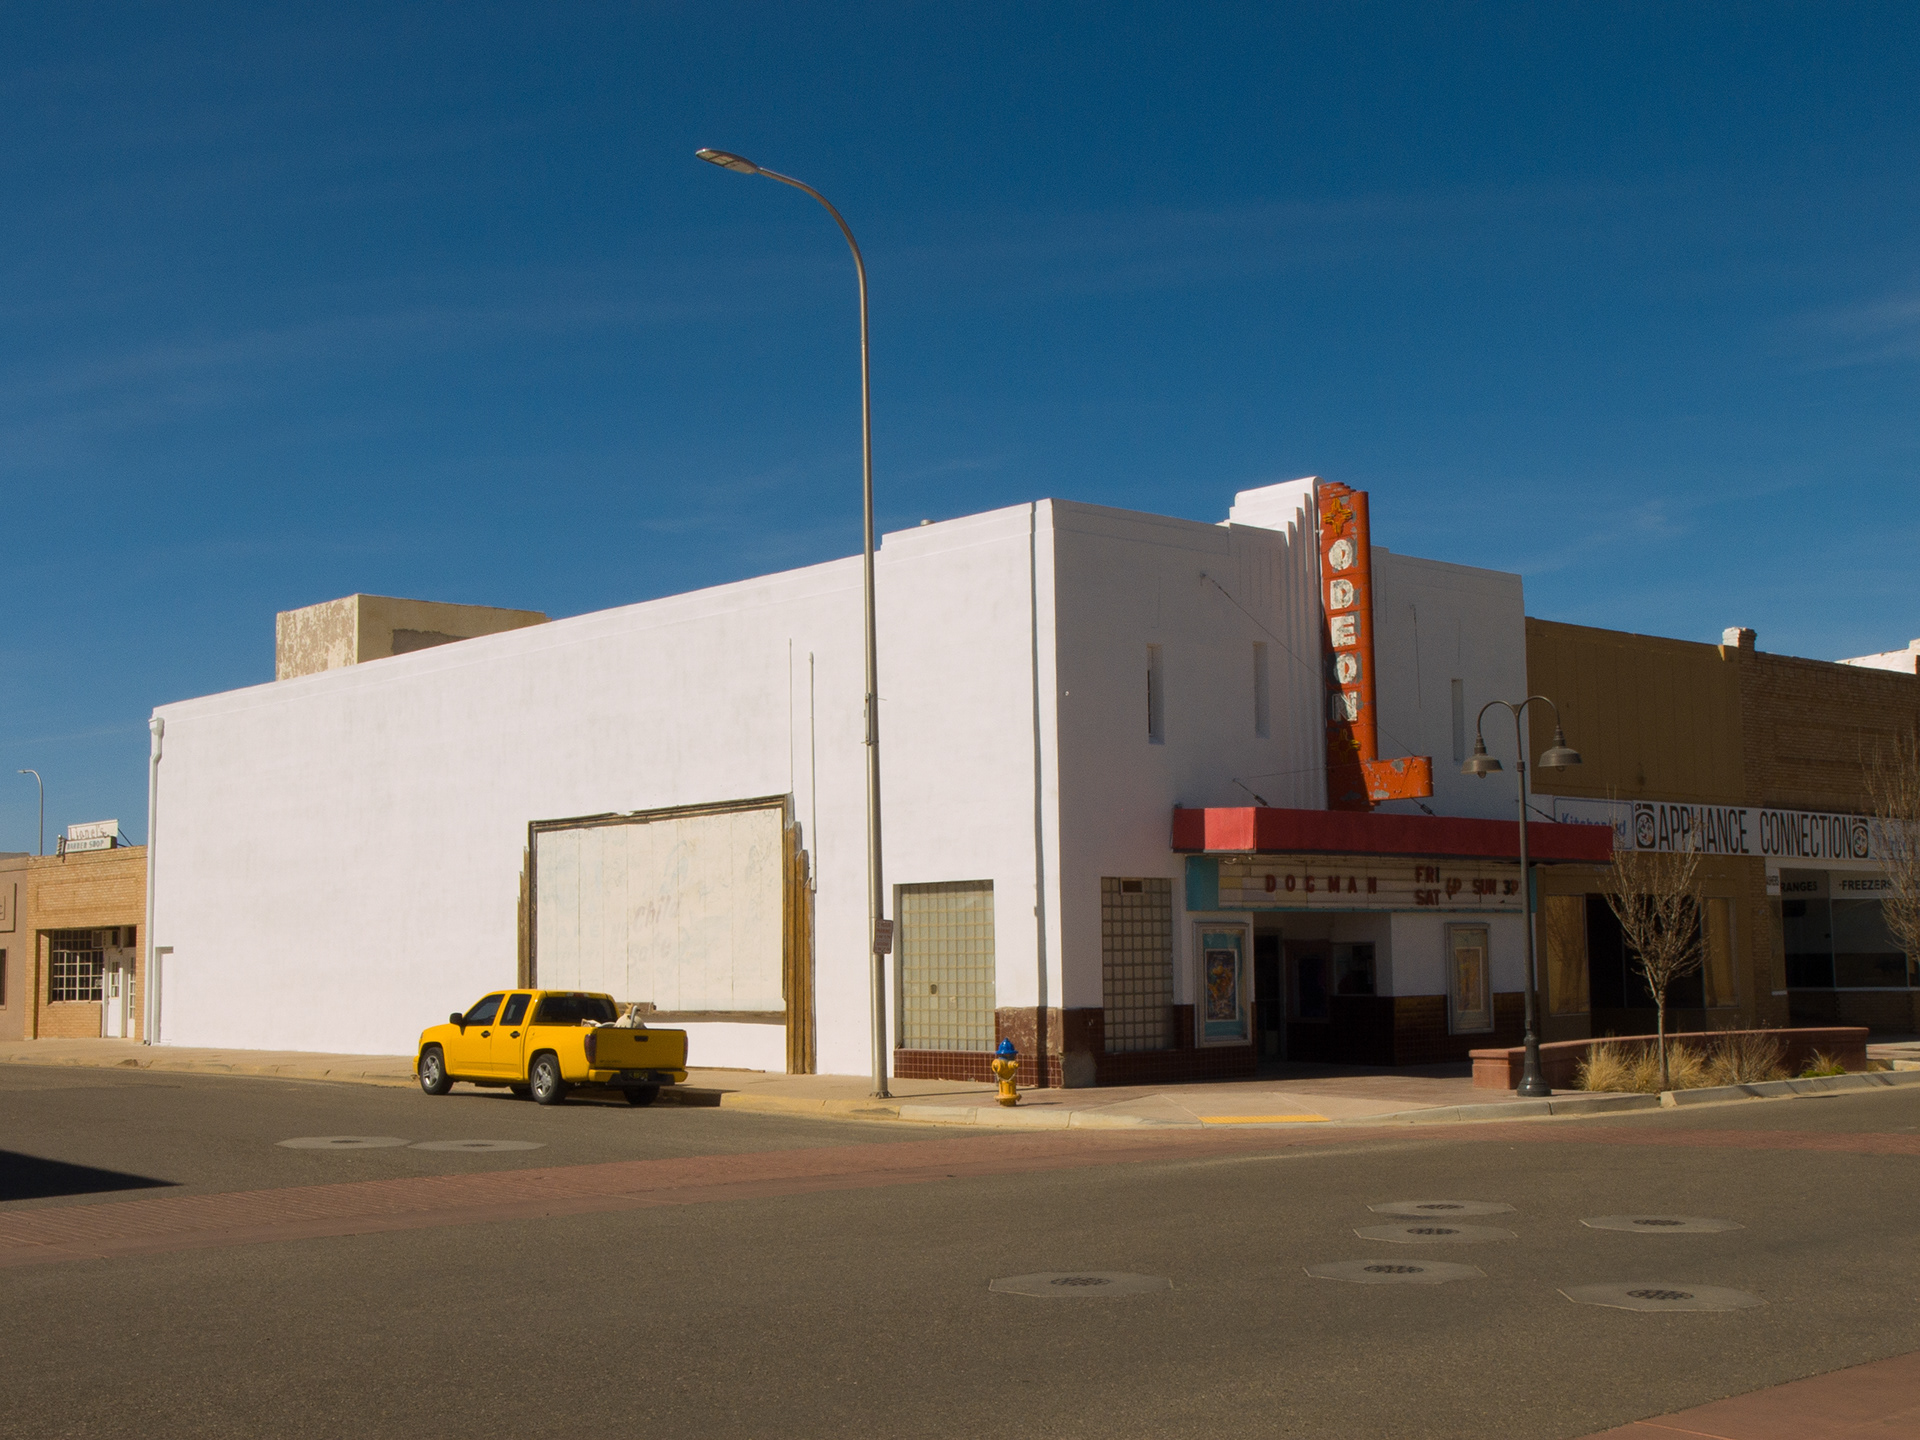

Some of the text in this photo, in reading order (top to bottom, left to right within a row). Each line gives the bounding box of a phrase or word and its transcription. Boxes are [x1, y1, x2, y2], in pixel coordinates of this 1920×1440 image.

[1328, 539, 1359, 722] ODEON
[1659, 805, 1750, 854] APPLIANCE
[1760, 811, 1852, 859] CONNECTION
[1415, 866, 1440, 884] FRI
[1780, 881, 1818, 893] RANGES
[1414, 889, 1441, 906] SAT
